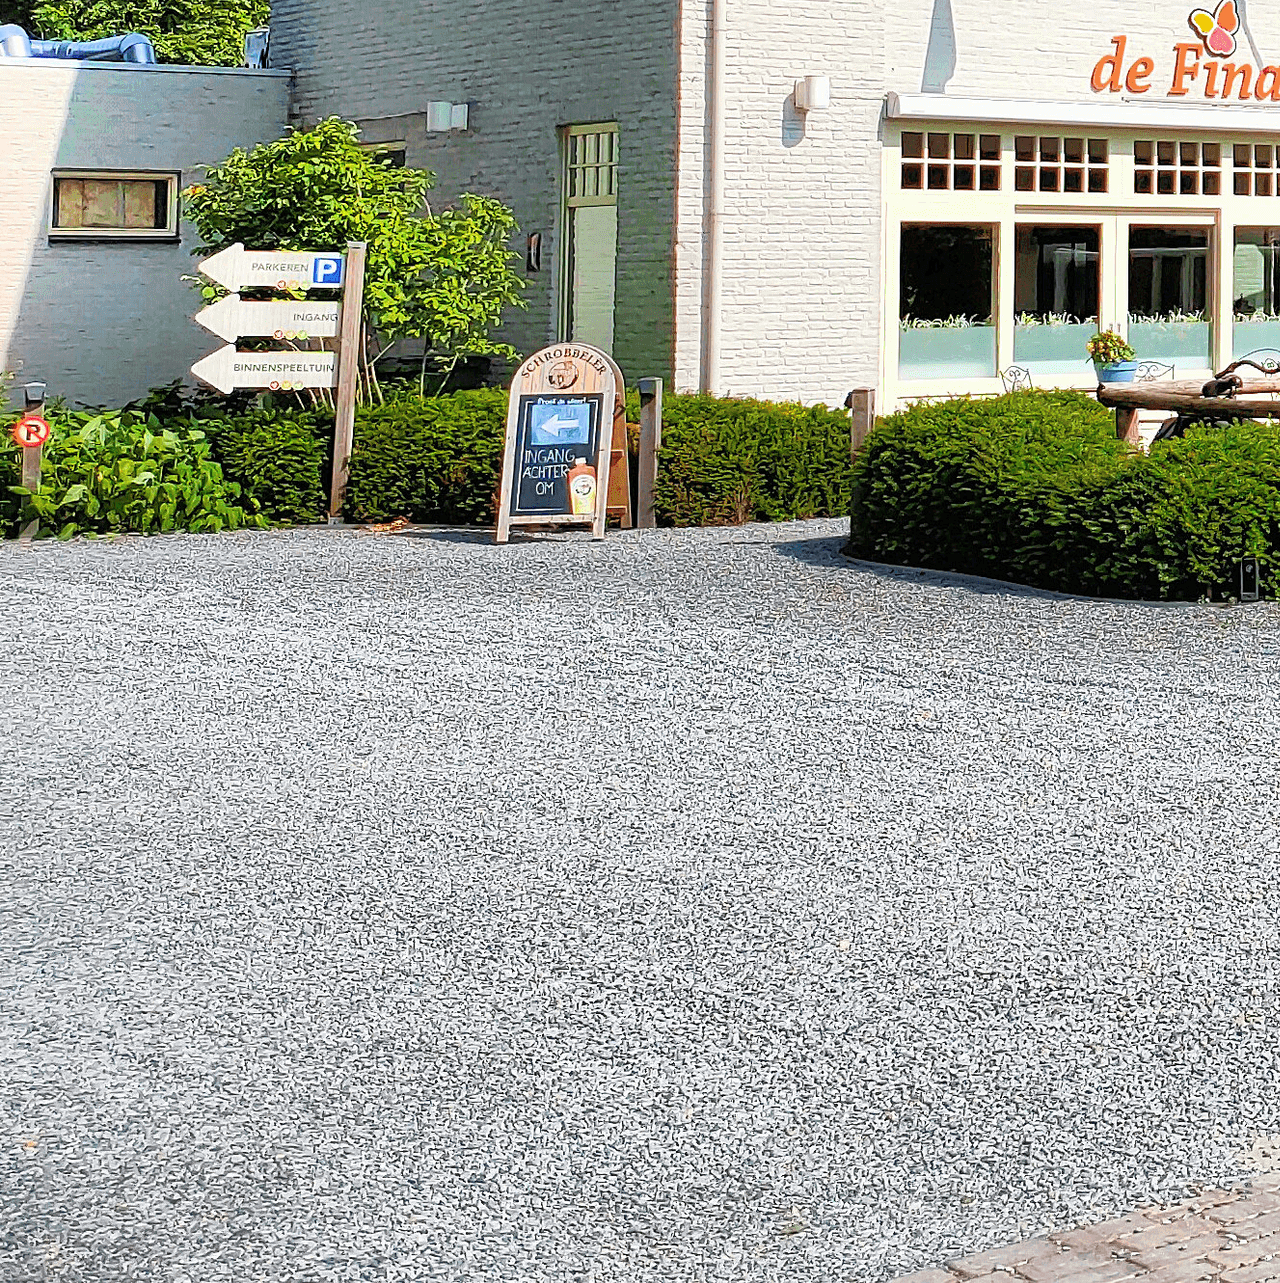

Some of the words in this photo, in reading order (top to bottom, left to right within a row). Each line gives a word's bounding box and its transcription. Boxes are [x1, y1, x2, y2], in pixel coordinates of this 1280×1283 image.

[1089, 34, 1155, 93] de
[251, 262, 309, 272] PARKEREN
[293, 313, 339, 322] INGANG
[233, 363, 335, 373] BINNENSPEELTUIN
[521, 347, 607, 378] SCHROBBELER
[524, 448, 576, 463] INGANG
[522, 464, 571, 478] ACHTER
[535, 481, 555, 495] OM
